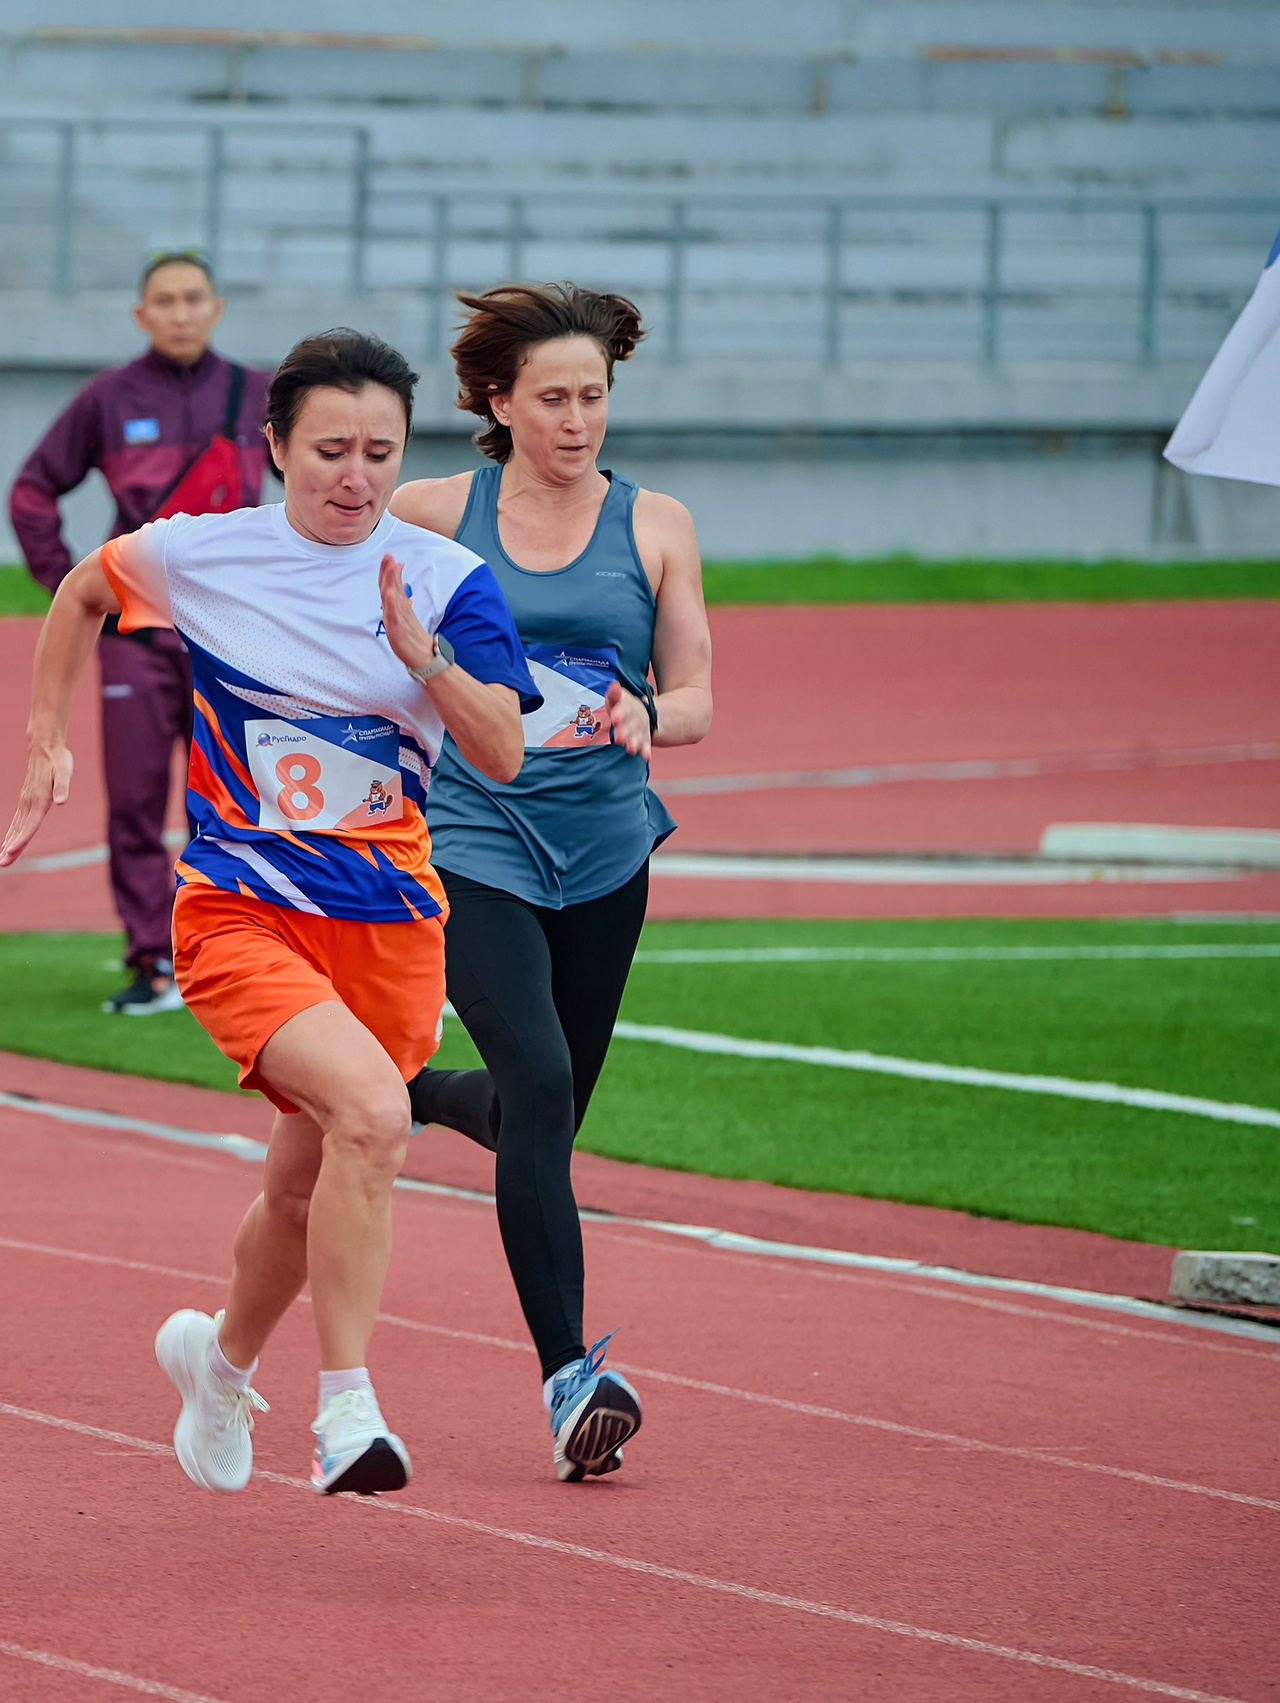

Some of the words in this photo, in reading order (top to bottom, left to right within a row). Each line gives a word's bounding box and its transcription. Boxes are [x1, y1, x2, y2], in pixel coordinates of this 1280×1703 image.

[358, 724, 395, 736] СПАРТАКИАДА
[272, 735, 307, 743] РусГидро
[275, 752, 325, 821] 8
